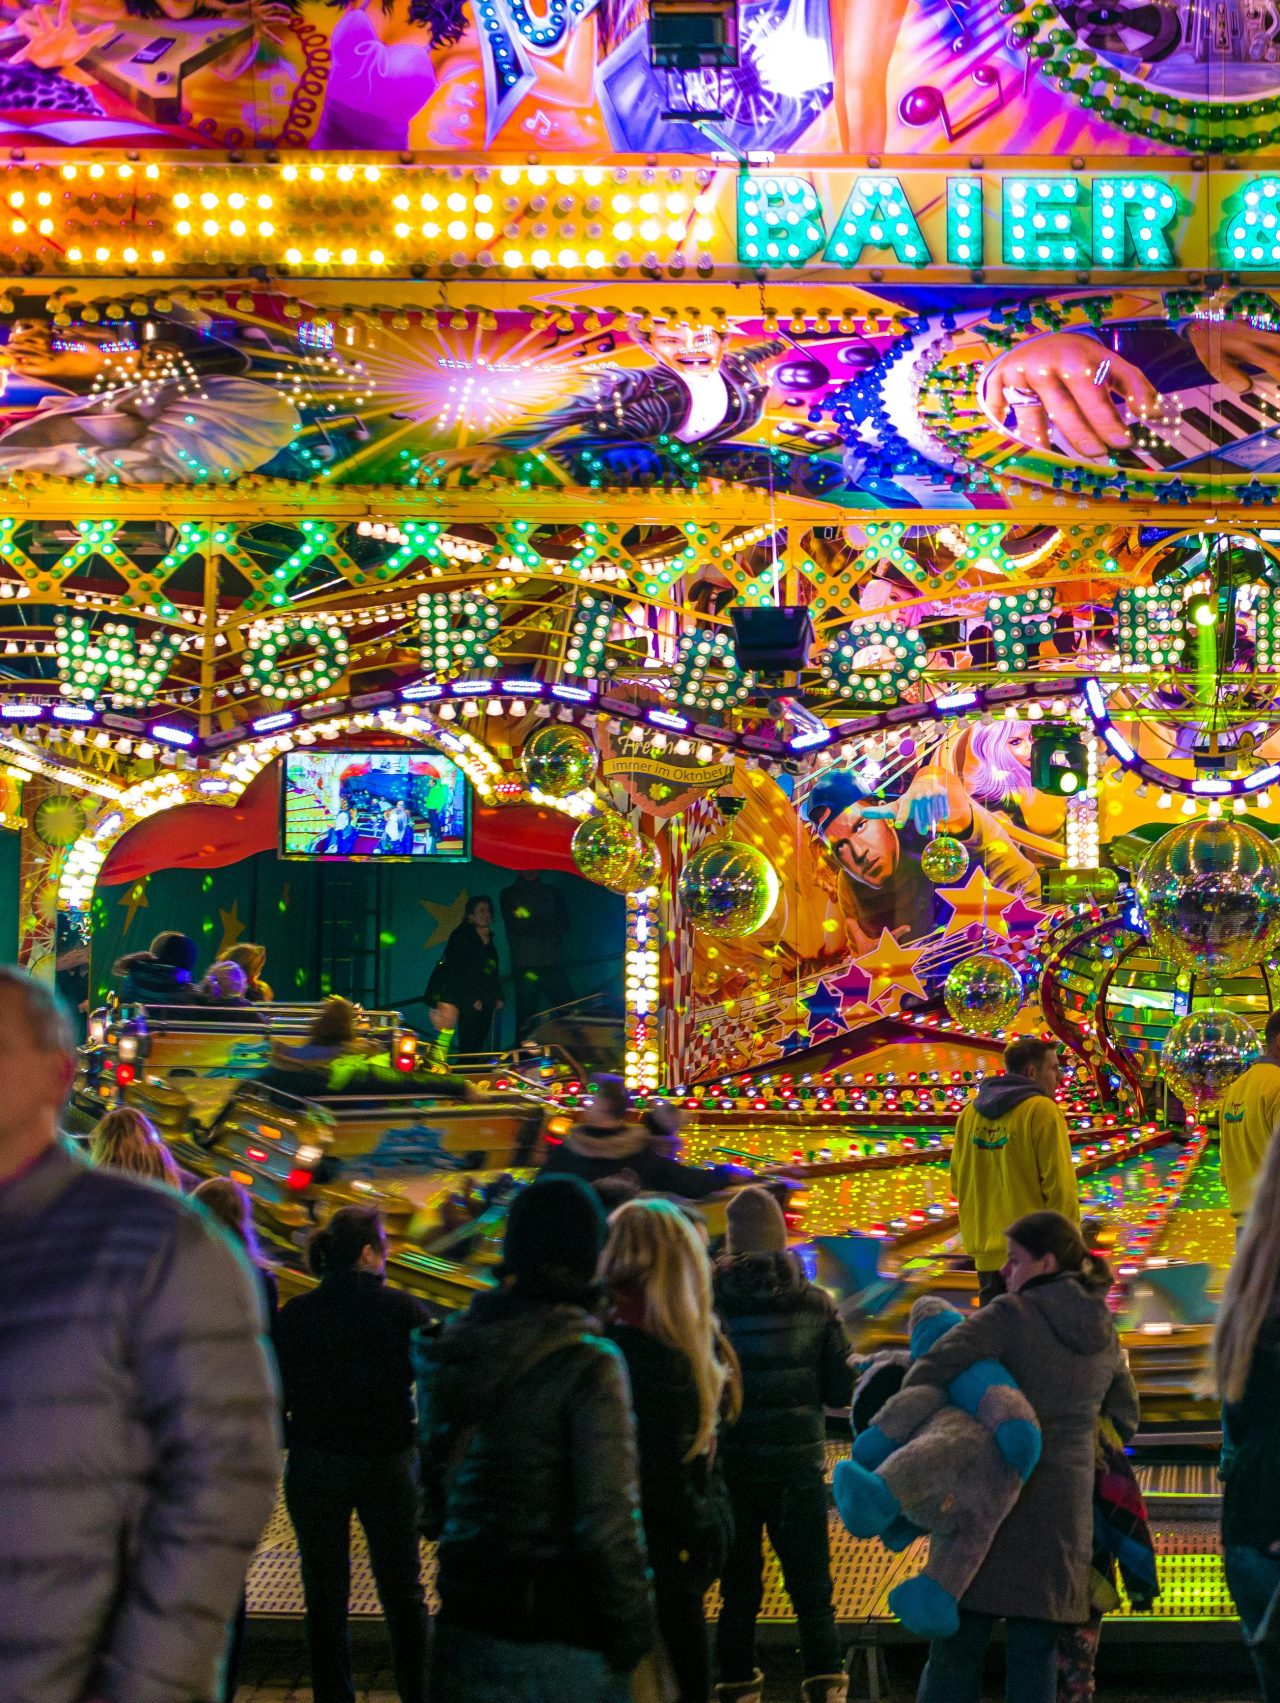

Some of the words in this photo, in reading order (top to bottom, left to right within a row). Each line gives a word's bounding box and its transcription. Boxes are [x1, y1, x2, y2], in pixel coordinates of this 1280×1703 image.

[736, 176, 1181, 267] BAIER
[54, 592, 760, 710] WORLD
[820, 586, 1057, 704] OF
[612, 760, 652, 774] immer
[655, 764, 670, 778] im
